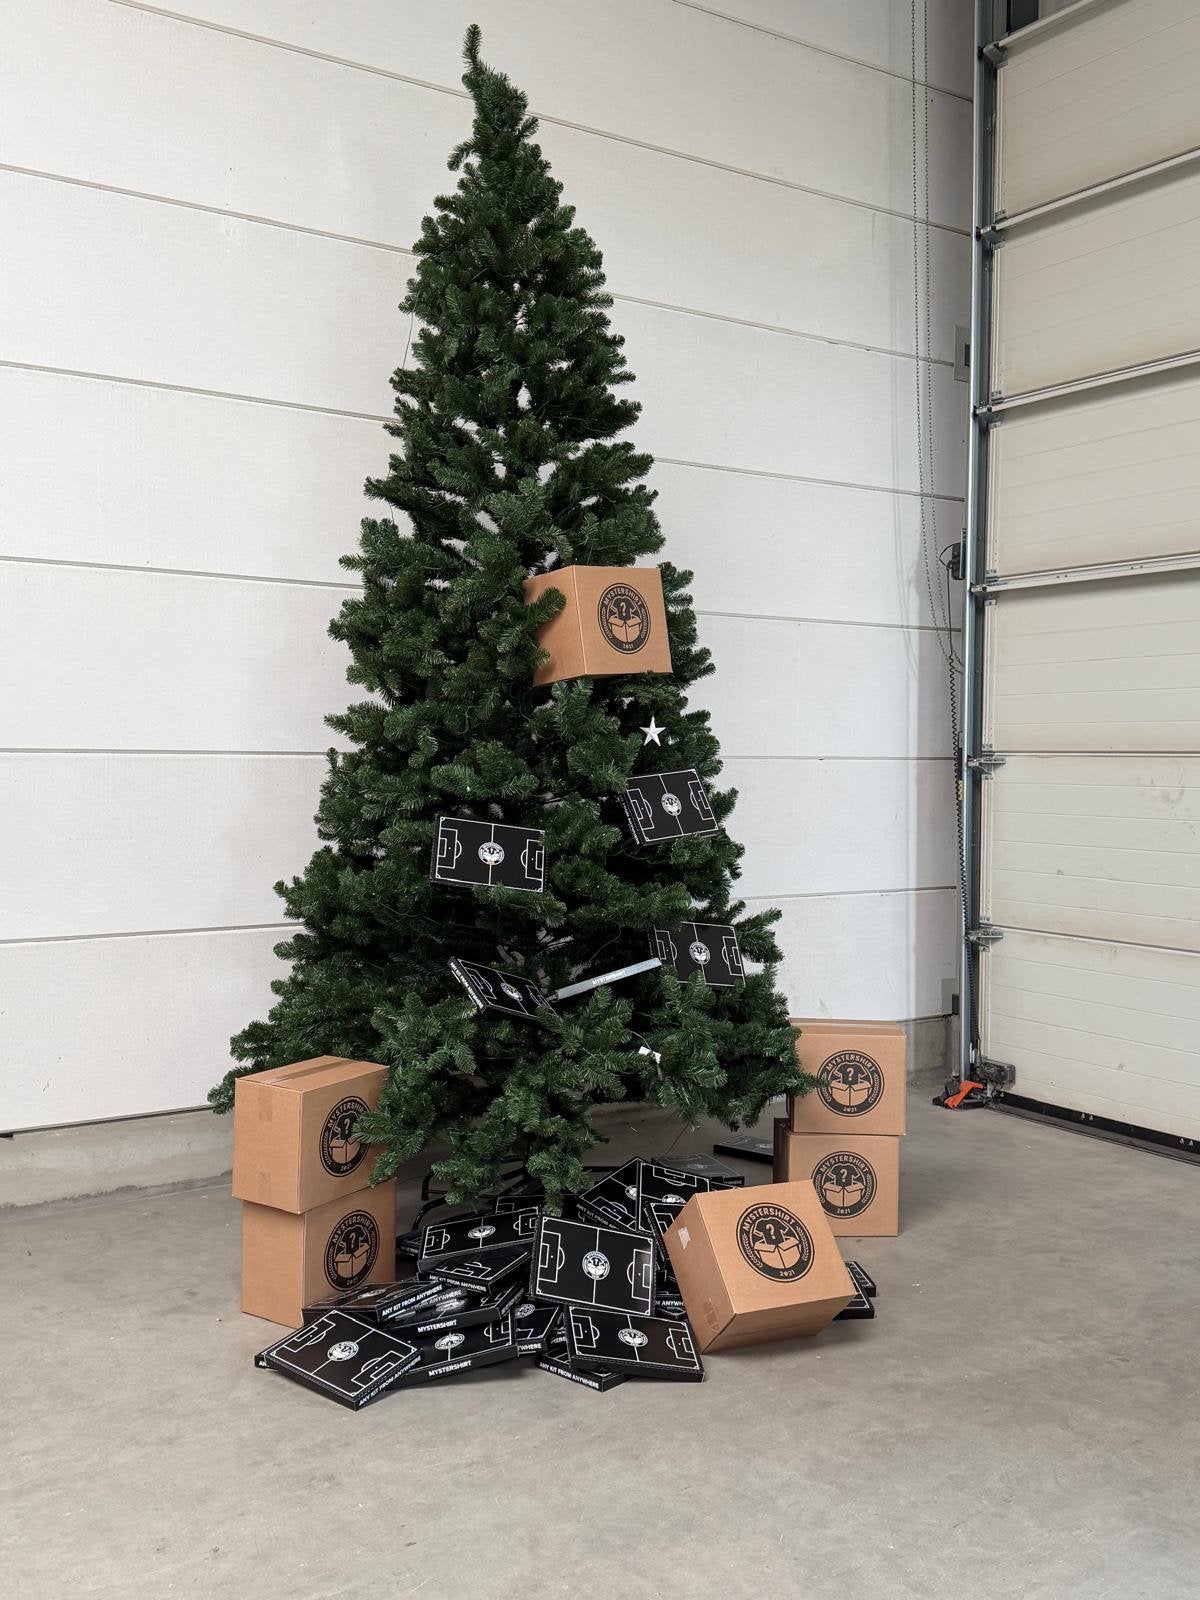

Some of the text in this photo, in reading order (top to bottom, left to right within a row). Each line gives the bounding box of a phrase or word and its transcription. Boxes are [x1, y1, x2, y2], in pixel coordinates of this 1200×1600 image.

[603, 587, 642, 605] MYSTERSHIRT
[826, 1054, 876, 1071] MYSTERSHIRT
[327, 1102, 365, 1128] MYSTERSHIR
[820, 1155, 868, 1172] MYSTERSHIRT
[742, 1207, 796, 1231] MYSTERSHIRT
[332, 1216, 374, 1243] MYSTERSHIRT
[382, 1284, 442, 1317] ANY KIT FROM ANYWHERE
[429, 1289, 462, 1304] ANYWHERE
[417, 1319, 457, 1333] MYSTERSHIRT
[517, 1343, 542, 1351] WHERE
[428, 1360, 471, 1377] MYSTERSHIRT
[540, 1361, 550, 1370] ANY
[557, 1368, 571, 1379] FROM
[572, 1374, 599, 1389] ANYWHERE
[359, 1395, 370, 1406] ANY
[379, 1376, 394, 1390] FROM
[394, 1355, 421, 1379] ANYWHERE
